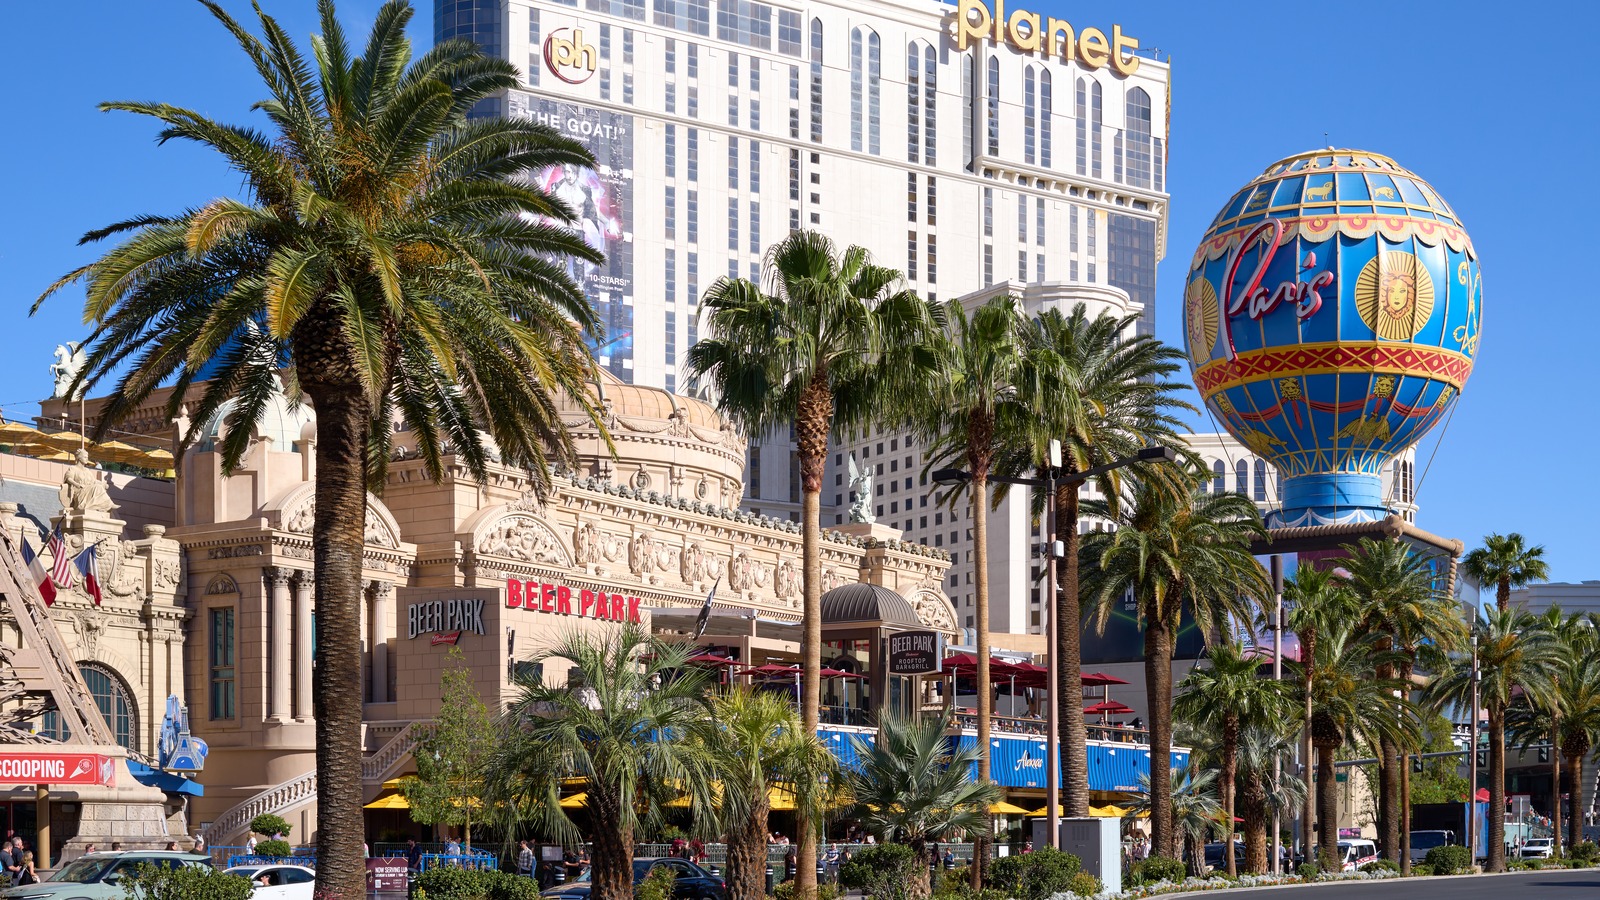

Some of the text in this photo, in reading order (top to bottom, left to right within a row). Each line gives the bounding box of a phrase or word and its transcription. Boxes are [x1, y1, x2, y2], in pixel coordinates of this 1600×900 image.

[550, 29, 596, 72] ph
[958, 0, 1140, 75] planet
[1219, 217, 1334, 363] Paris
[408, 598, 486, 640] BEER PARK
[507, 578, 642, 624] BEER PARK
[892, 635, 934, 655] BEER PARK
[0, 759, 65, 778] COOPING
